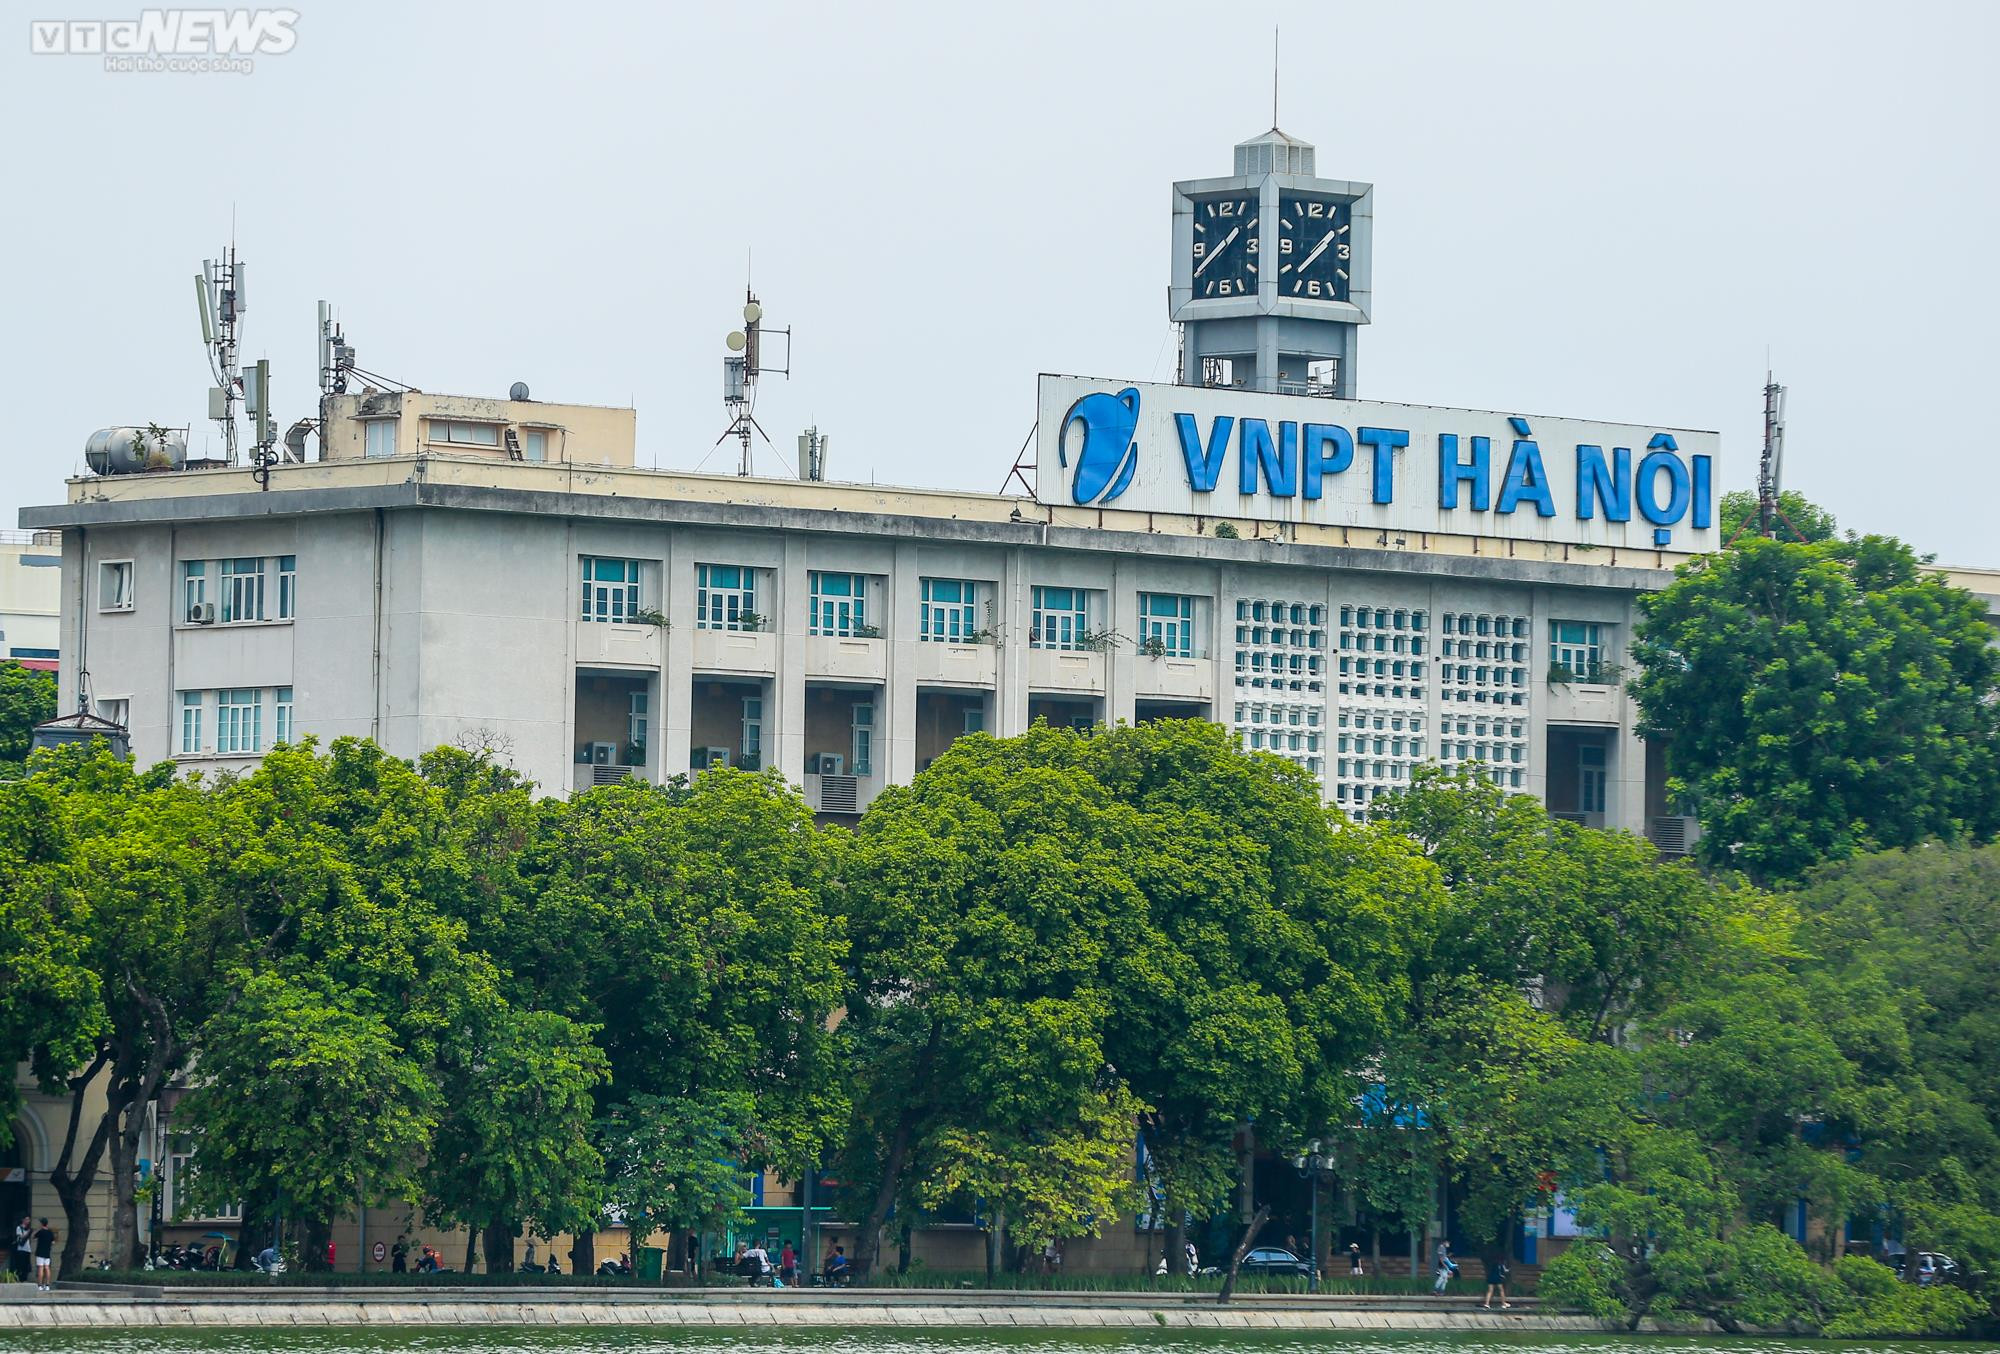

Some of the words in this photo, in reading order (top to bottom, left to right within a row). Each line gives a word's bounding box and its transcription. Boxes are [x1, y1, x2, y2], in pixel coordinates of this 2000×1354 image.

[1219, 202, 1233, 217] 12
[1308, 203, 1323, 218] 12
[1193, 242, 1206, 257] 9
[1246, 238, 1258, 253] 3
[1280, 238, 1293, 254] 9
[1337, 244, 1350, 260] 3
[1219, 279, 1231, 294] 6
[1307, 280, 1320, 296] 6
[1174, 413, 1411, 505] VNPT
[1438, 417, 1557, 518] HÀ
[1576, 434, 1713, 545] NỘI
